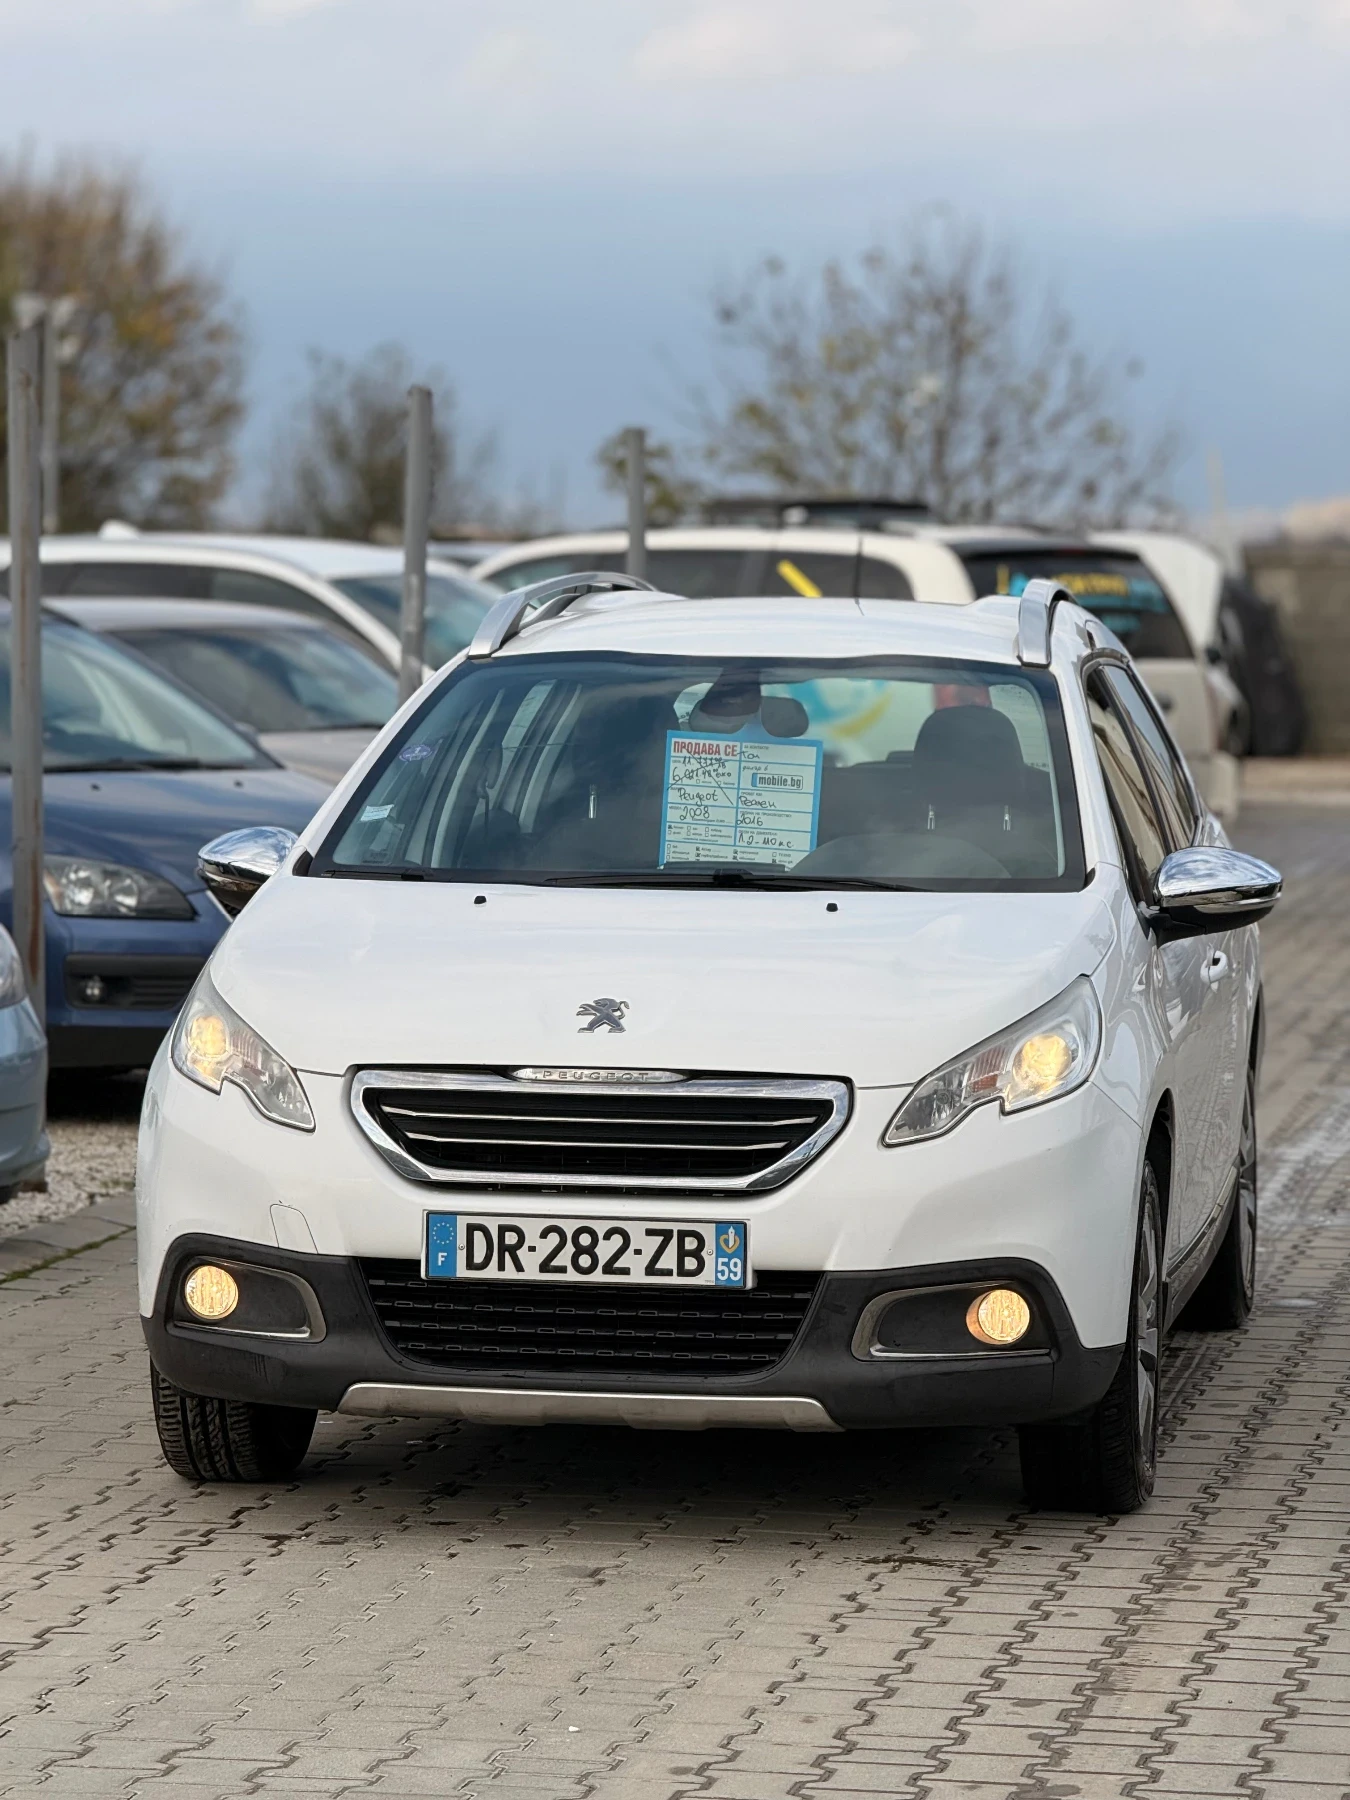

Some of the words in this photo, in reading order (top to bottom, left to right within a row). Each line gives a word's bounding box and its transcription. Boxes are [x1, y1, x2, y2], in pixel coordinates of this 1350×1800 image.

[673, 741, 721, 756] ПРОДАВА
[724, 744, 738, 757] СЕ
[758, 775, 801, 788] mobile.bg
[677, 787, 718, 807] Peugeot
[680, 805, 710, 821] 2008
[736, 813, 763, 826] 2016
[542, 1070, 649, 1082] PEUGEOT
[465, 1222, 706, 1277] DR-282-ZB
[437, 1252, 448, 1266] F
[716, 1257, 742, 1281] 59
